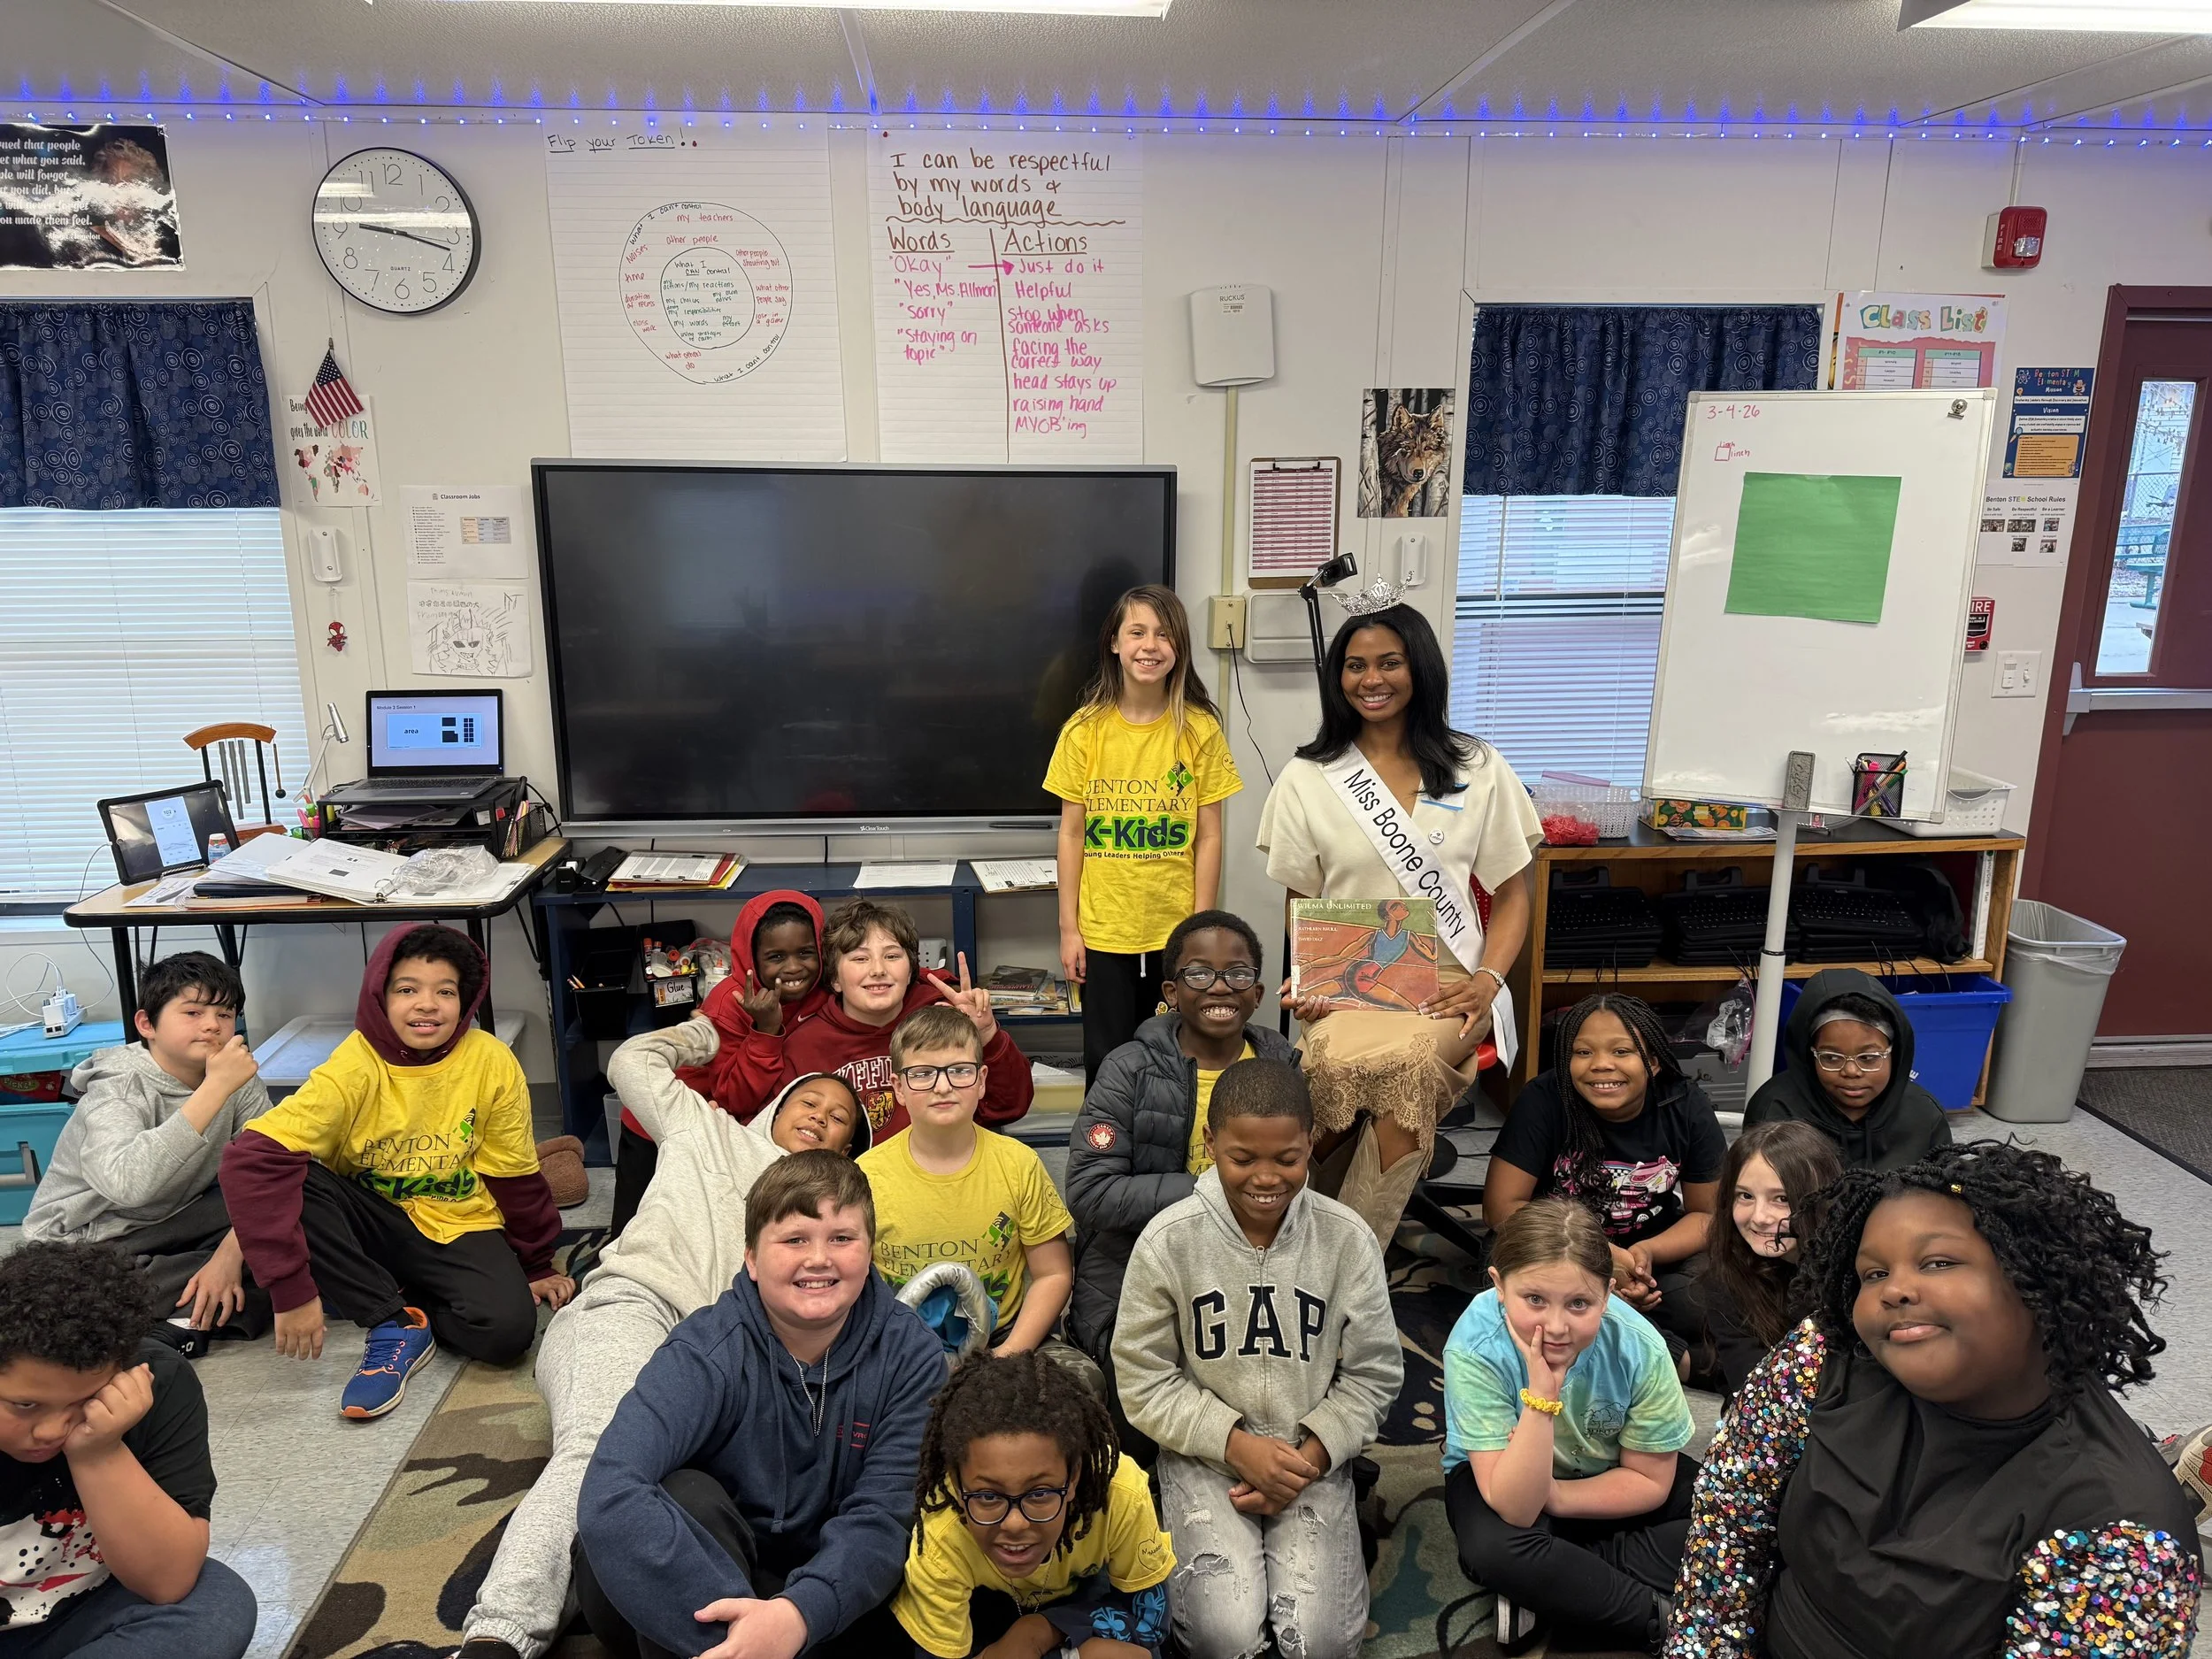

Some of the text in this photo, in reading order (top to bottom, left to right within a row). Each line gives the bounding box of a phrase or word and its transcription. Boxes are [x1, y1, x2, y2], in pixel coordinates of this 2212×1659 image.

[24, 138, 81, 153] that people
[547, 134, 576, 151] Flip
[586, 136, 616, 153] your
[12, 154, 37, 165] what
[40, 157, 59, 168] you
[890, 147, 1110, 176] I can be respectful
[17, 169, 68, 181] will forget
[358, 170, 374, 195] 11
[382, 163, 403, 186] 12
[419, 174, 424, 196] 1
[893, 171, 1062, 201] by my words &
[340, 195, 363, 212] 10
[659, 203, 679, 214] can't
[897, 195, 1062, 229] body language
[14, 216, 42, 225] made
[44, 216, 69, 226] them
[676, 213, 733, 224] my teachers
[332, 220, 348, 240] 9
[446, 227, 460, 245] 3
[692, 234, 718, 245] people
[1996, 224, 2006, 251] FIRE
[887, 226, 1087, 254] Words Actions
[343, 247, 358, 270] 8
[442, 252, 456, 273] 4
[749, 249, 768, 259] people
[1018, 257, 1104, 274] Just do it
[365, 268, 380, 292] 7
[395, 278, 411, 300] 6
[422, 272, 437, 293] 5
[1015, 280, 1071, 299] Helpful
[1047, 303, 1085, 322] when
[1859, 303, 1988, 334] Class List
[1008, 318, 1110, 334] someone asks
[961, 330, 978, 345] on
[1012, 336, 1087, 357] facing the
[1010, 354, 1102, 375] correct way
[2034, 368, 2080, 378] Beton STM
[1013, 373, 1118, 395] head stays up
[2037, 377, 2072, 388] Elmentay
[289, 399, 308, 414] Being
[1012, 395, 1104, 419] raising hand
[1707, 404, 1761, 419] 3-4-26
[332, 420, 369, 439] COLOR
[1015, 415, 1087, 439] MYOB'ing
[1970, 601, 1992, 612] IRE
[1085, 818, 1187, 849] K-Kids
[1103, 849, 1131, 859] Leaders
[1344, 768, 1466, 940] Miss Boone County
[1326, 901, 1372, 910] UNLIMITED
[666, 981, 685, 993] Glue
[880, 1239, 979, 1261] BENTON
[881, 1248, 1016, 1276] ELEMTARY
[1191, 1284, 1327, 1363] GAP
